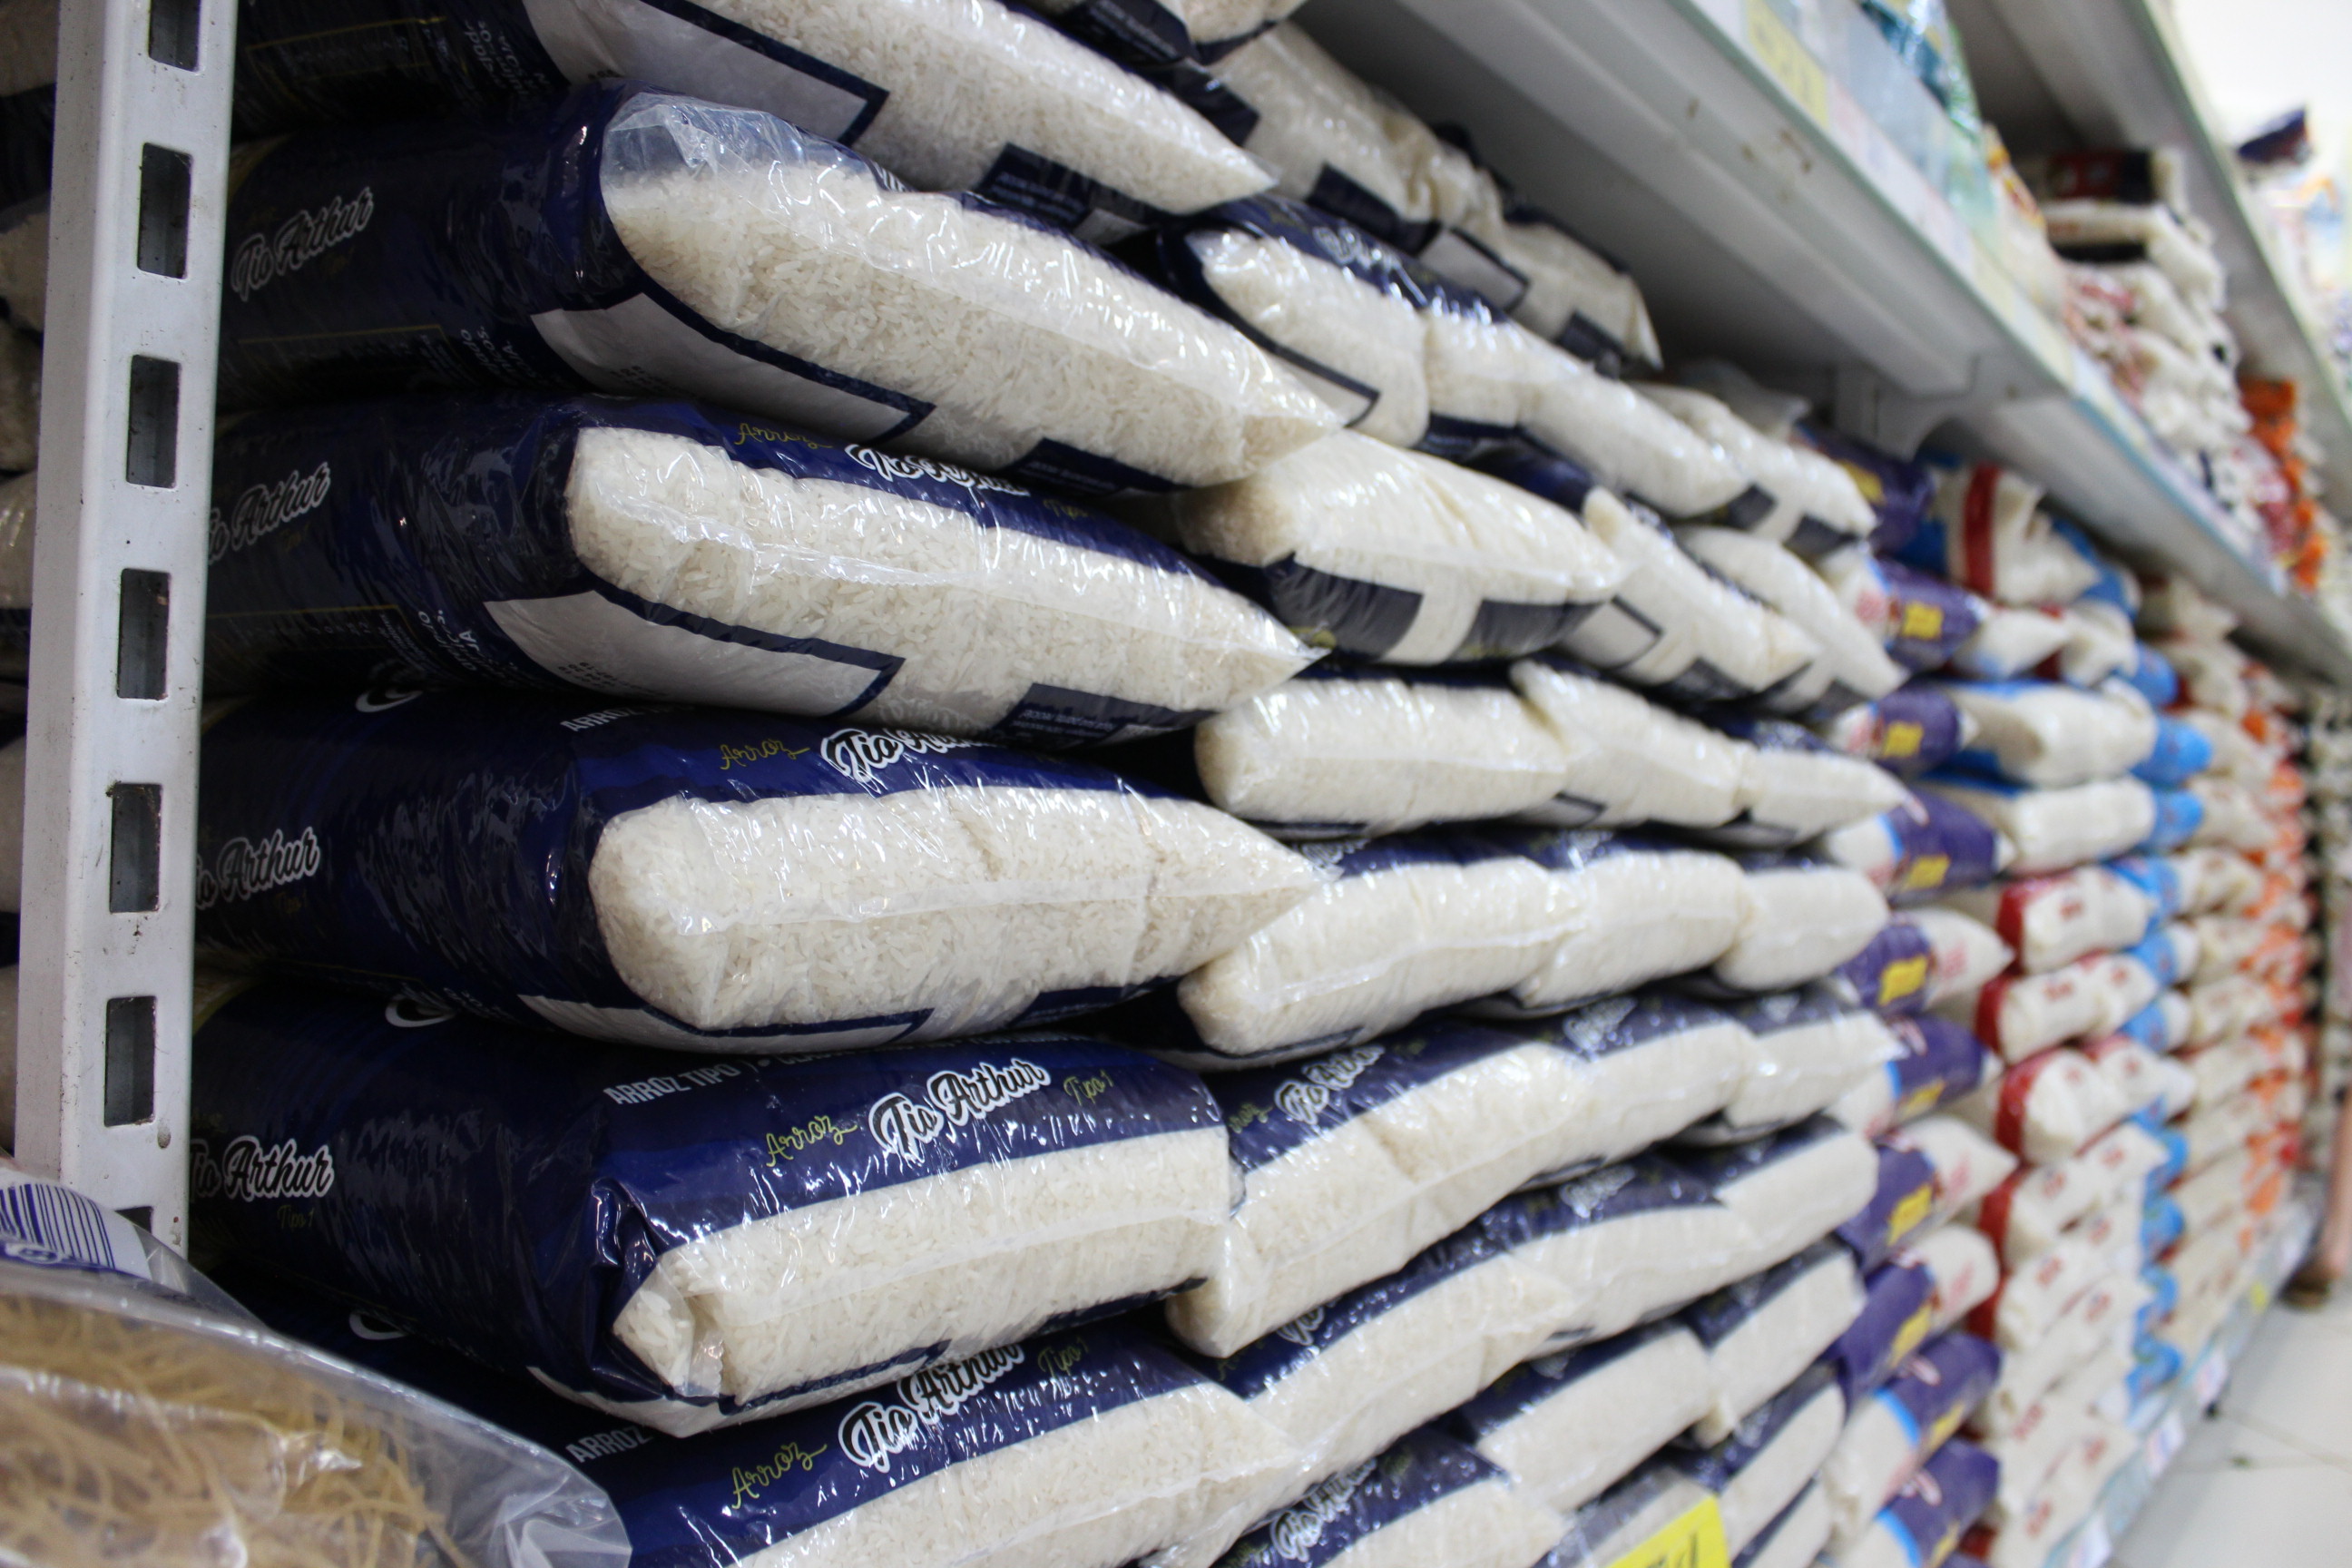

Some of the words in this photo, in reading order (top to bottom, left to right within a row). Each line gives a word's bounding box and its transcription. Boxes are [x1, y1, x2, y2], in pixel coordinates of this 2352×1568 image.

[230, 232, 273, 302] Tio
[274, 186, 375, 276] Arthur
[231, 461, 331, 552] Arthur
[559, 706, 643, 732] ARROZ
[720, 737, 810, 770] Arroz
[820, 728, 904, 784] Tio
[216, 826, 321, 903] Arthur
[603, 1076, 691, 1105] ARROZ
[677, 1063, 742, 1087] TIPO
[868, 1092, 945, 1162] Tio
[926, 1057, 1053, 1126] Arthur
[1063, 1074, 1104, 1106] Tipo
[222, 1134, 336, 1203] Arthur
[764, 1115, 858, 1167] Arroz
[1037, 1346, 1082, 1378] Tipo
[564, 1425, 653, 1464] ARROZ
[838, 1400, 919, 1474] Tio
[731, 1439, 827, 1510] Arroz
